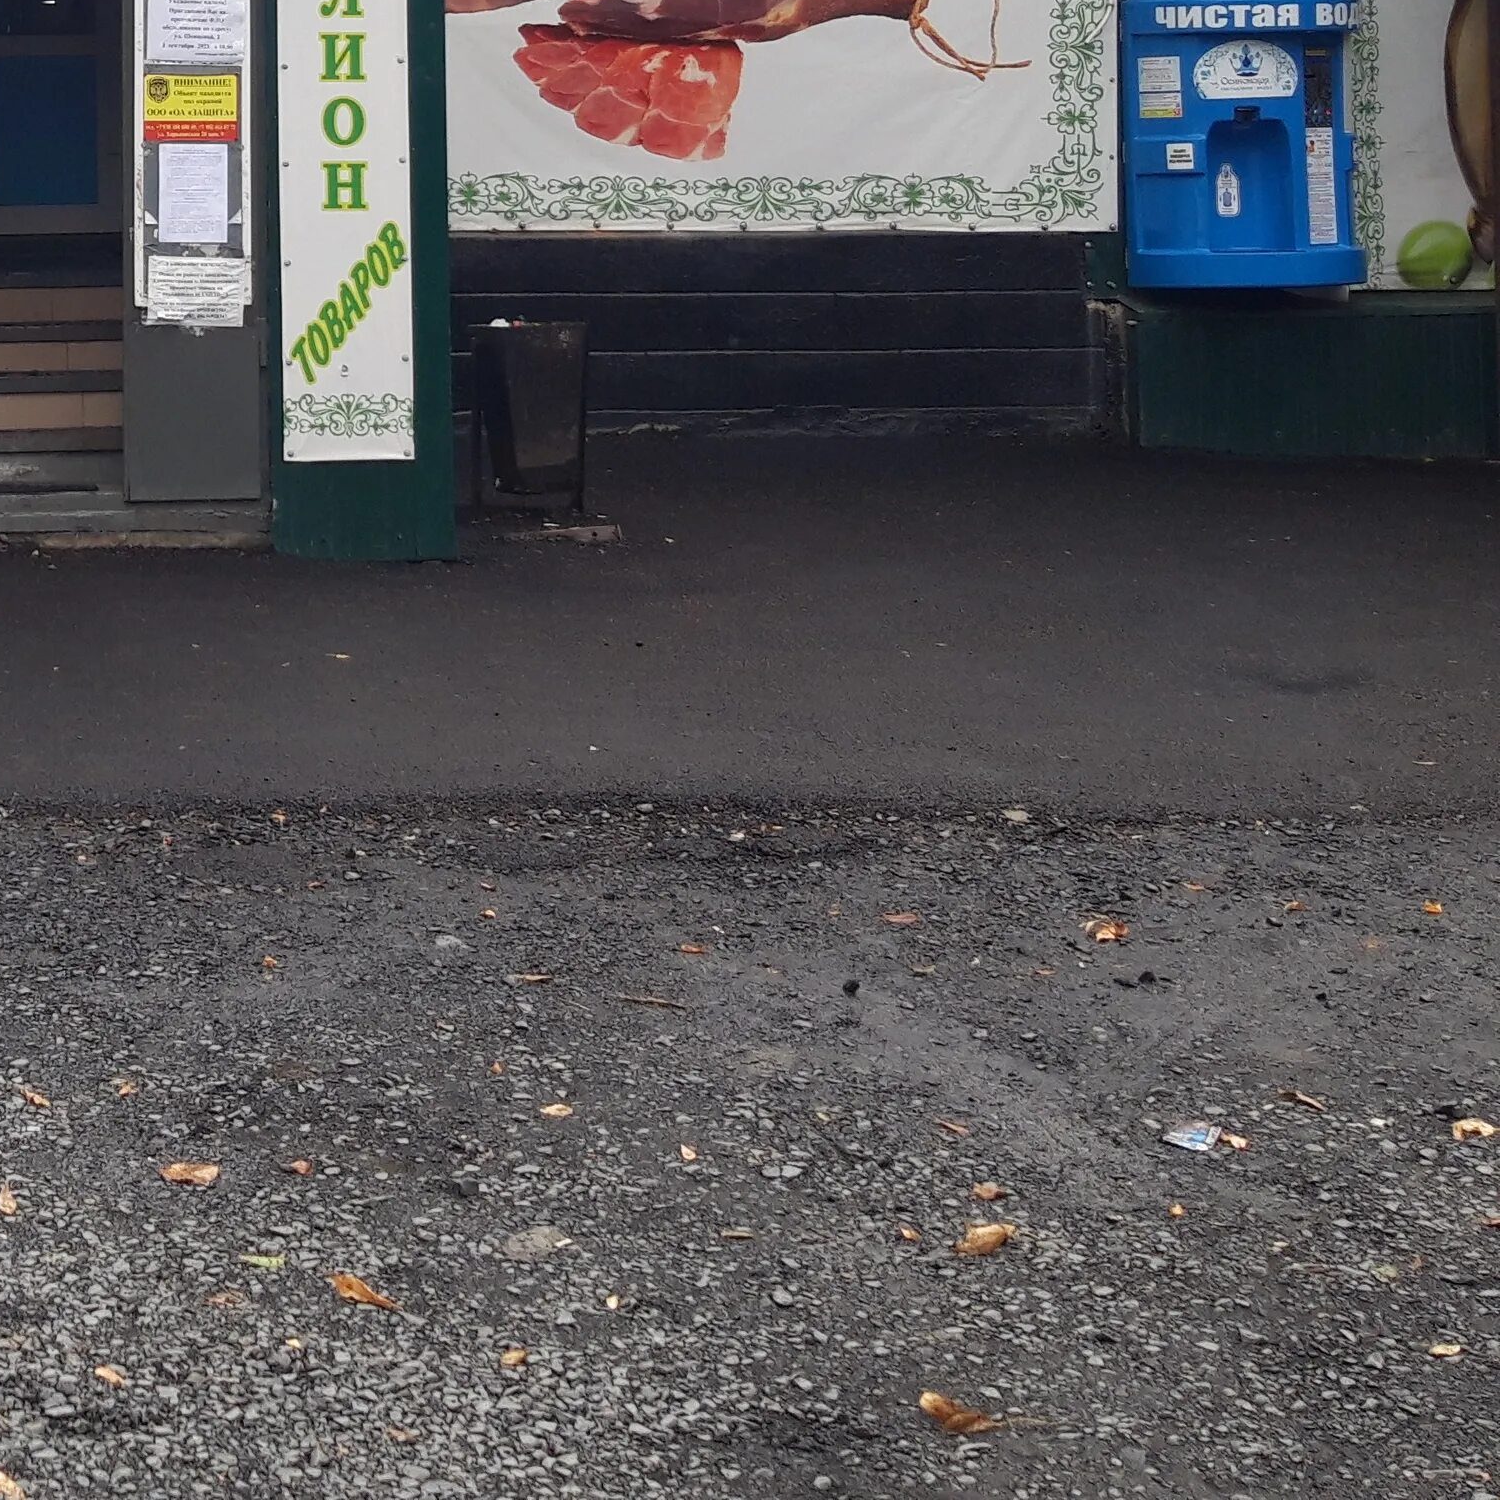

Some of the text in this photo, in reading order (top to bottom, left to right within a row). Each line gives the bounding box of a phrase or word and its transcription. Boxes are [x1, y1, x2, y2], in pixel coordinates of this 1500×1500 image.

[173, 78, 232, 87] ВНИМАНИЕ!
[146, 108, 166, 116] ООО
[290, 220, 408, 384] ТОВАРОВ
